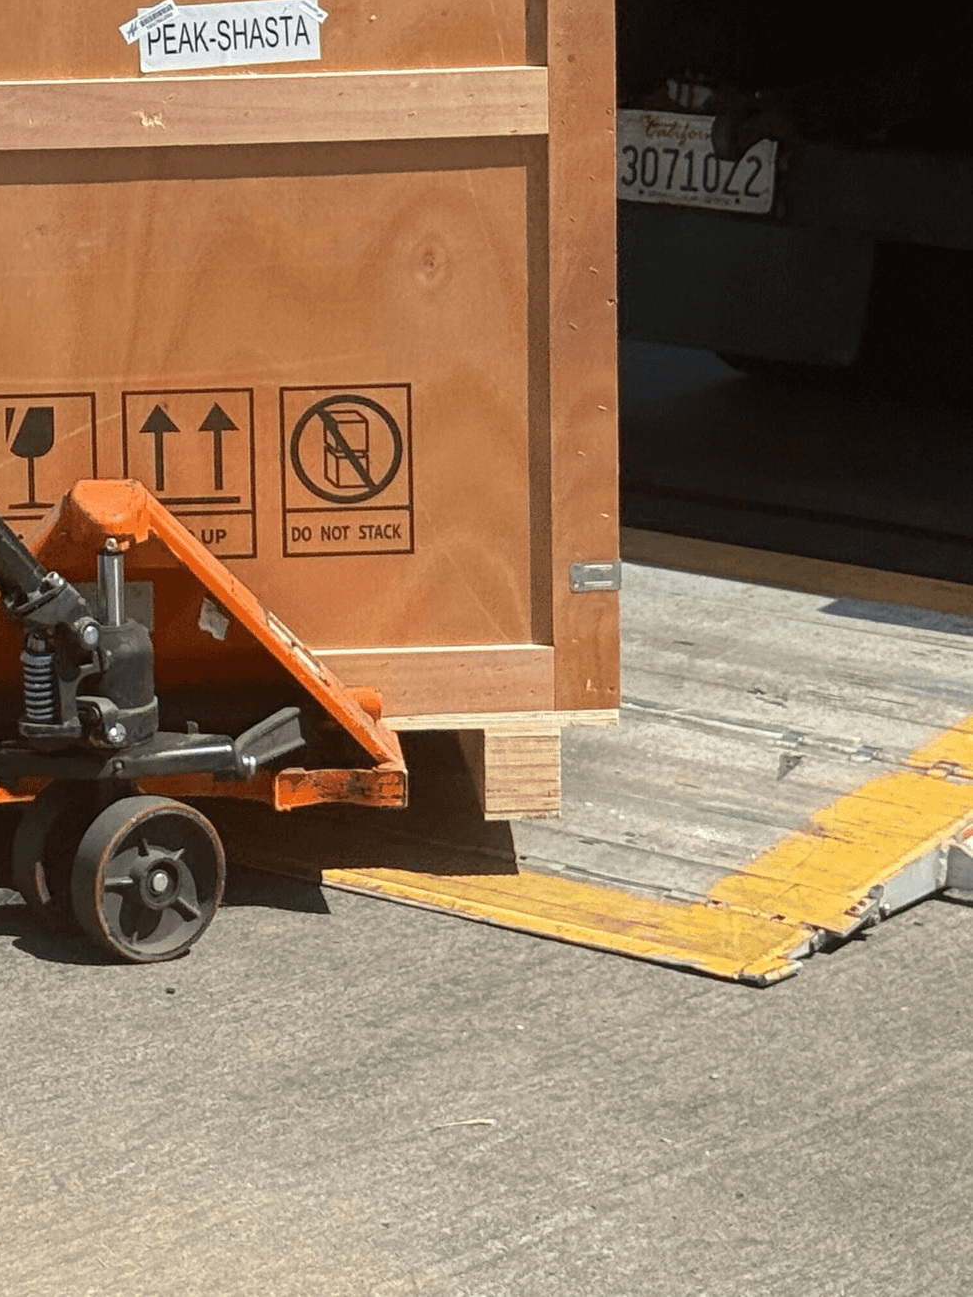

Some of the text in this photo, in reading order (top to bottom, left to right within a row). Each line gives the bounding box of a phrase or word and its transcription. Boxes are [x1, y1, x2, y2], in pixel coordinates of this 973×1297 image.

[147, 15, 310, 55] PEAK-SHASTA
[291, 523, 402, 542] DO NOT STACK
